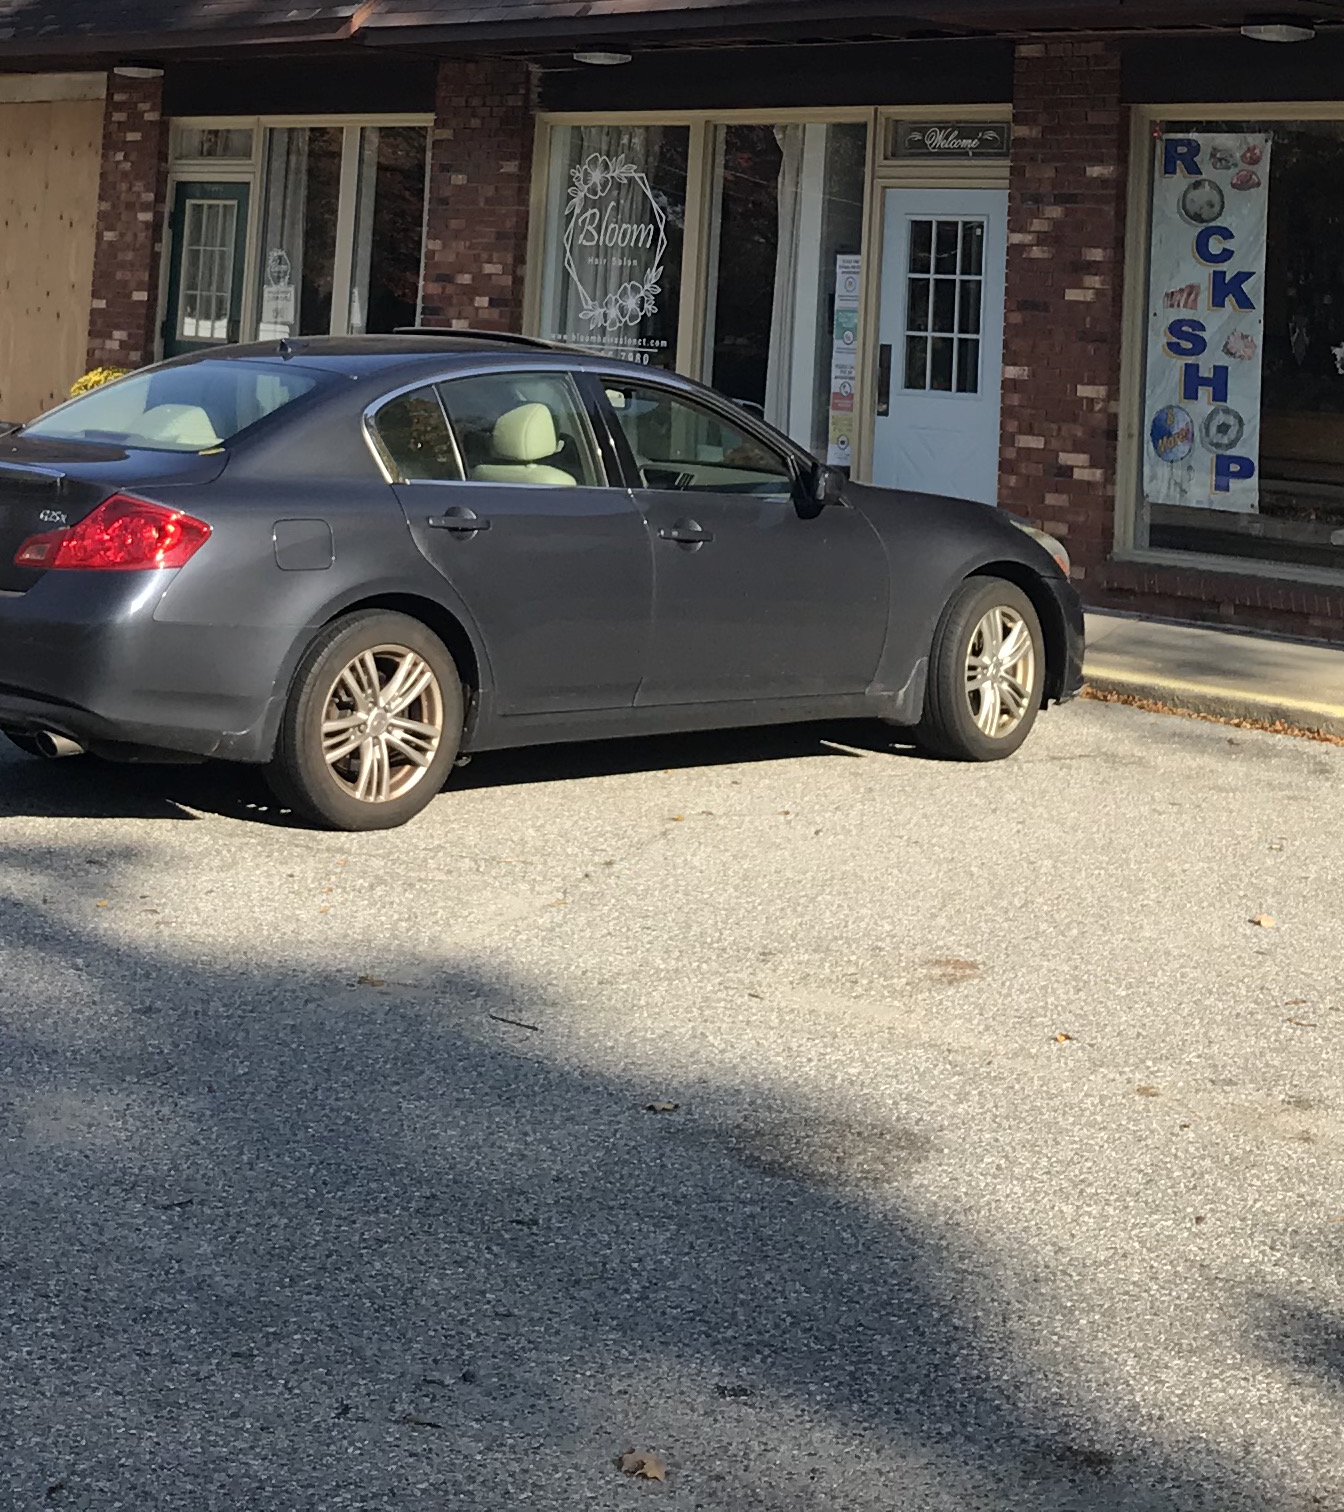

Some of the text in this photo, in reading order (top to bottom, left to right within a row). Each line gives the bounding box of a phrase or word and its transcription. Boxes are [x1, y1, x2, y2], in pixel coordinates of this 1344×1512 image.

[924, 127, 982, 152] Welcome
[577, 200, 655, 249] Bloom
[587, 256, 638, 266] Hair Salon
